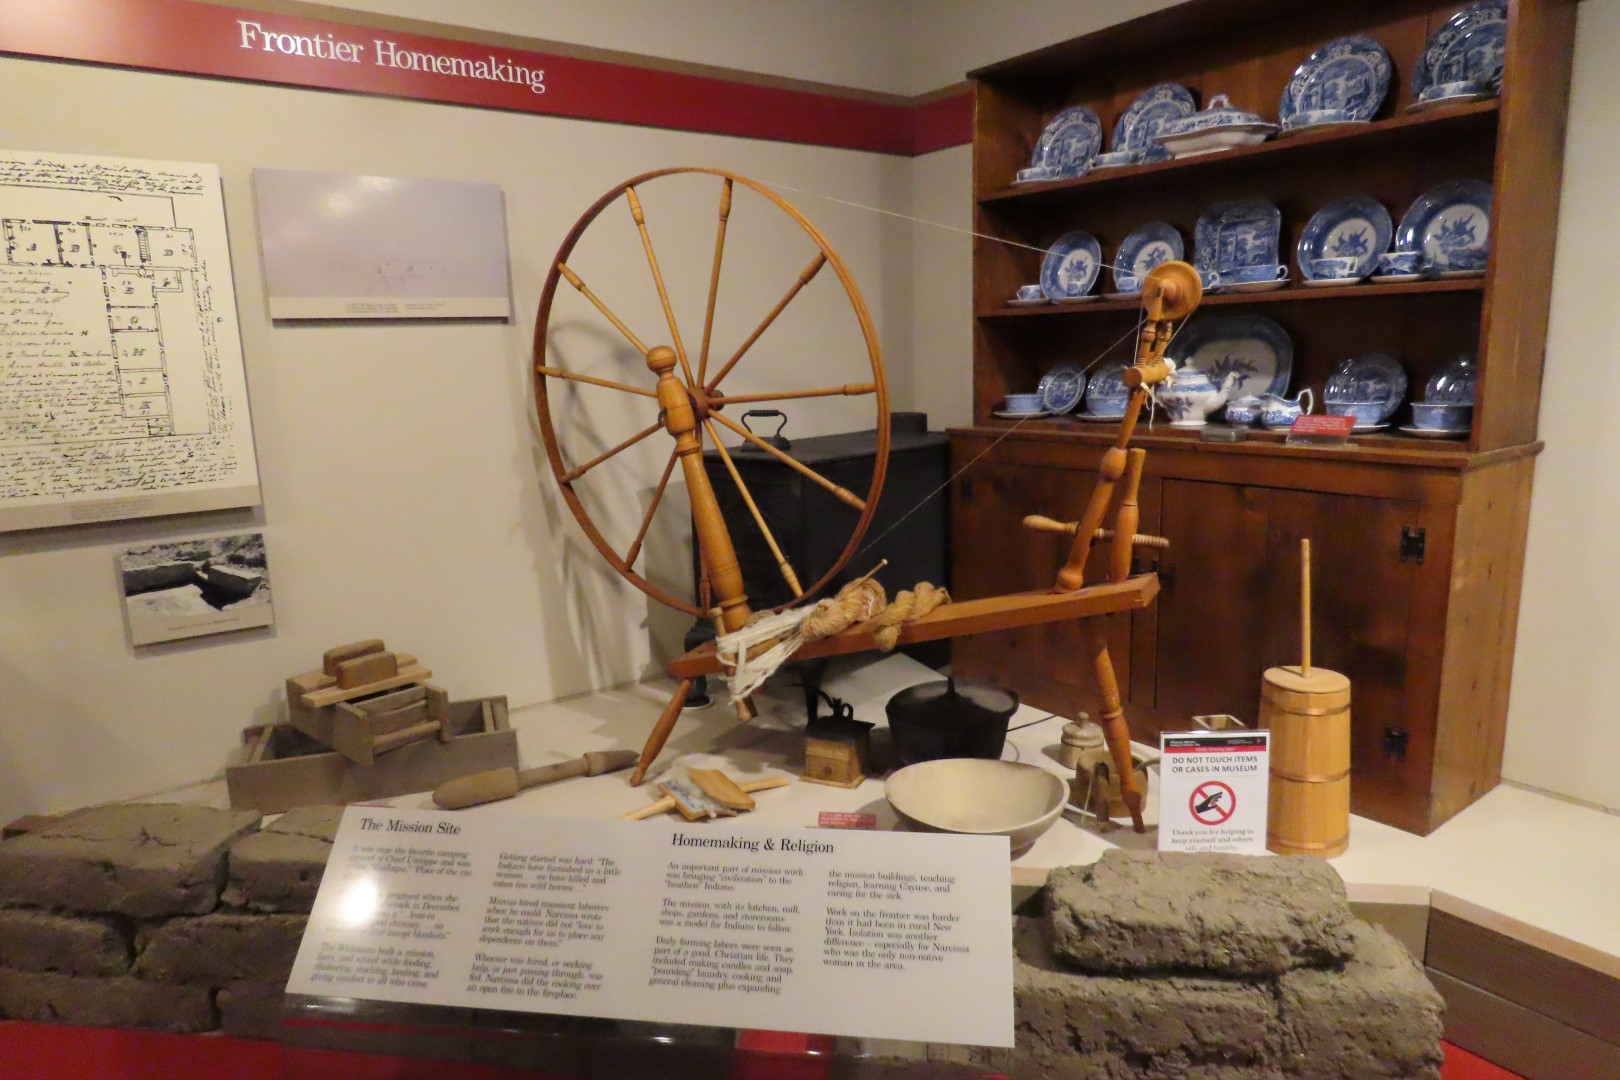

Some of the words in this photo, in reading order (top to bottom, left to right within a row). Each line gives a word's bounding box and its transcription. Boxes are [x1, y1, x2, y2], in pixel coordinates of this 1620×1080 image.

[236, 20, 363, 63] Frontier
[374, 39, 546, 94] Homemaking
[360, 818, 382, 830] The
[386, 820, 432, 833] Mission
[436, 822, 461, 834] Site
[672, 833, 760, 851] Homemaking
[764, 838, 775, 850] &
[781, 838, 834, 854] Religion
[500, 852, 527, 862] Getting
[682, 864, 719, 872] important
[722, 865, 739, 873] part
[683, 872, 715, 882] bringing
[780, 877, 792, 885] the
[920, 874, 955, 884] teaching
[863, 881, 896, 891] learning
[935, 884, 950, 892] and
[828, 890, 854, 899] caring
[663, 898, 677, 907] The
[723, 912, 738, 920] and
[826, 907, 847, 916] Work
[863, 909, 876, 917] the
[879, 910, 910, 919] frontier
[933, 913, 961, 922] harder
[517, 918, 543, 926] natives
[546, 918, 558, 927] did
[685, 919, 708, 928] model
[724, 920, 754, 930] Indians
[857, 919, 872, 927] had
[875, 919, 895, 929] been
[909, 921, 930, 930] rural
[934, 922, 952, 931] New
[849, 928, 884, 938] Isolation
[906, 931, 938, 941] another
[656, 935, 676, 946] Daily
[680, 938, 711, 948] farming
[714, 939, 738, 949] labors
[824, 937, 864, 947] difference
[875, 940, 915, 950] especially
[918, 942, 929, 950] for
[933, 943, 970, 953] Narcissa
[654, 946, 670, 955] part
[715, 950, 753, 961] Christian
[774, 954, 794, 963] They
[824, 947, 841, 955] who
[862, 949, 876, 957] the
[878, 950, 896, 960] only
[900, 952, 944, 961] non-native
[653, 956, 686, 965] included
[689, 958, 719, 969] making
[722, 960, 751, 970] candles
[755, 963, 770, 972] and
[823, 958, 854, 967] woman
[857, 958, 864, 967] in
[867, 960, 881, 968] the
[732, 971, 762, 982] cooking
[766, 974, 782, 982] and
[527, 987, 540, 996] the
[648, 977, 679, 985] general
[682, 978, 715, 990] cleaning
[718, 981, 735, 991] plus
[738, 982, 780, 994] expanding
